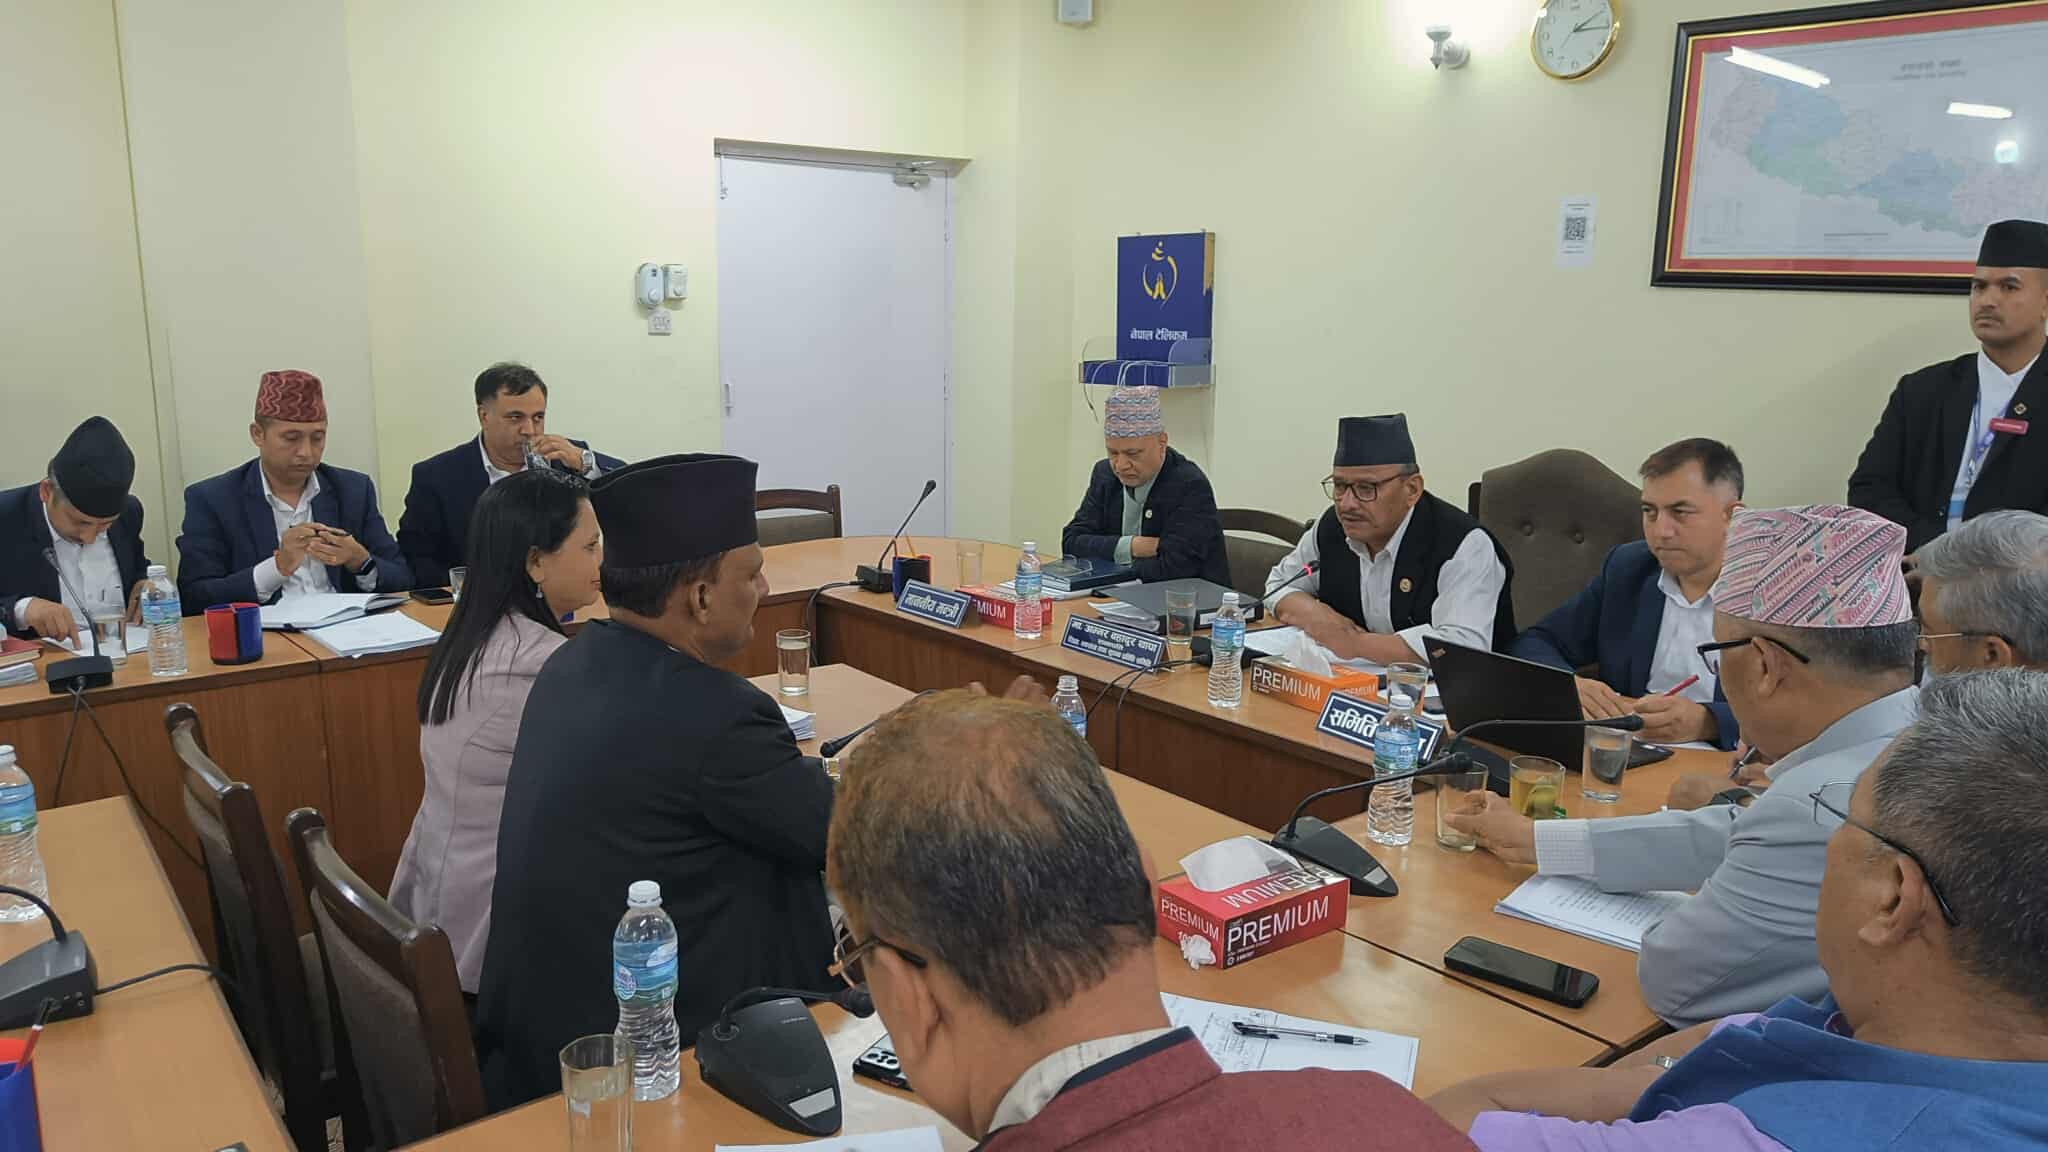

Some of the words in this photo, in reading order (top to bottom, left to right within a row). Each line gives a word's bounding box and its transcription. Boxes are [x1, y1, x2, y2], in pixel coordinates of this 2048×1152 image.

[971, 599, 1007, 619] MIUM
[1252, 666, 1321, 702] PREMIUM
[1161, 896, 1220, 942] PREMIUM
[1227, 896, 1329, 952] PREMIUM
